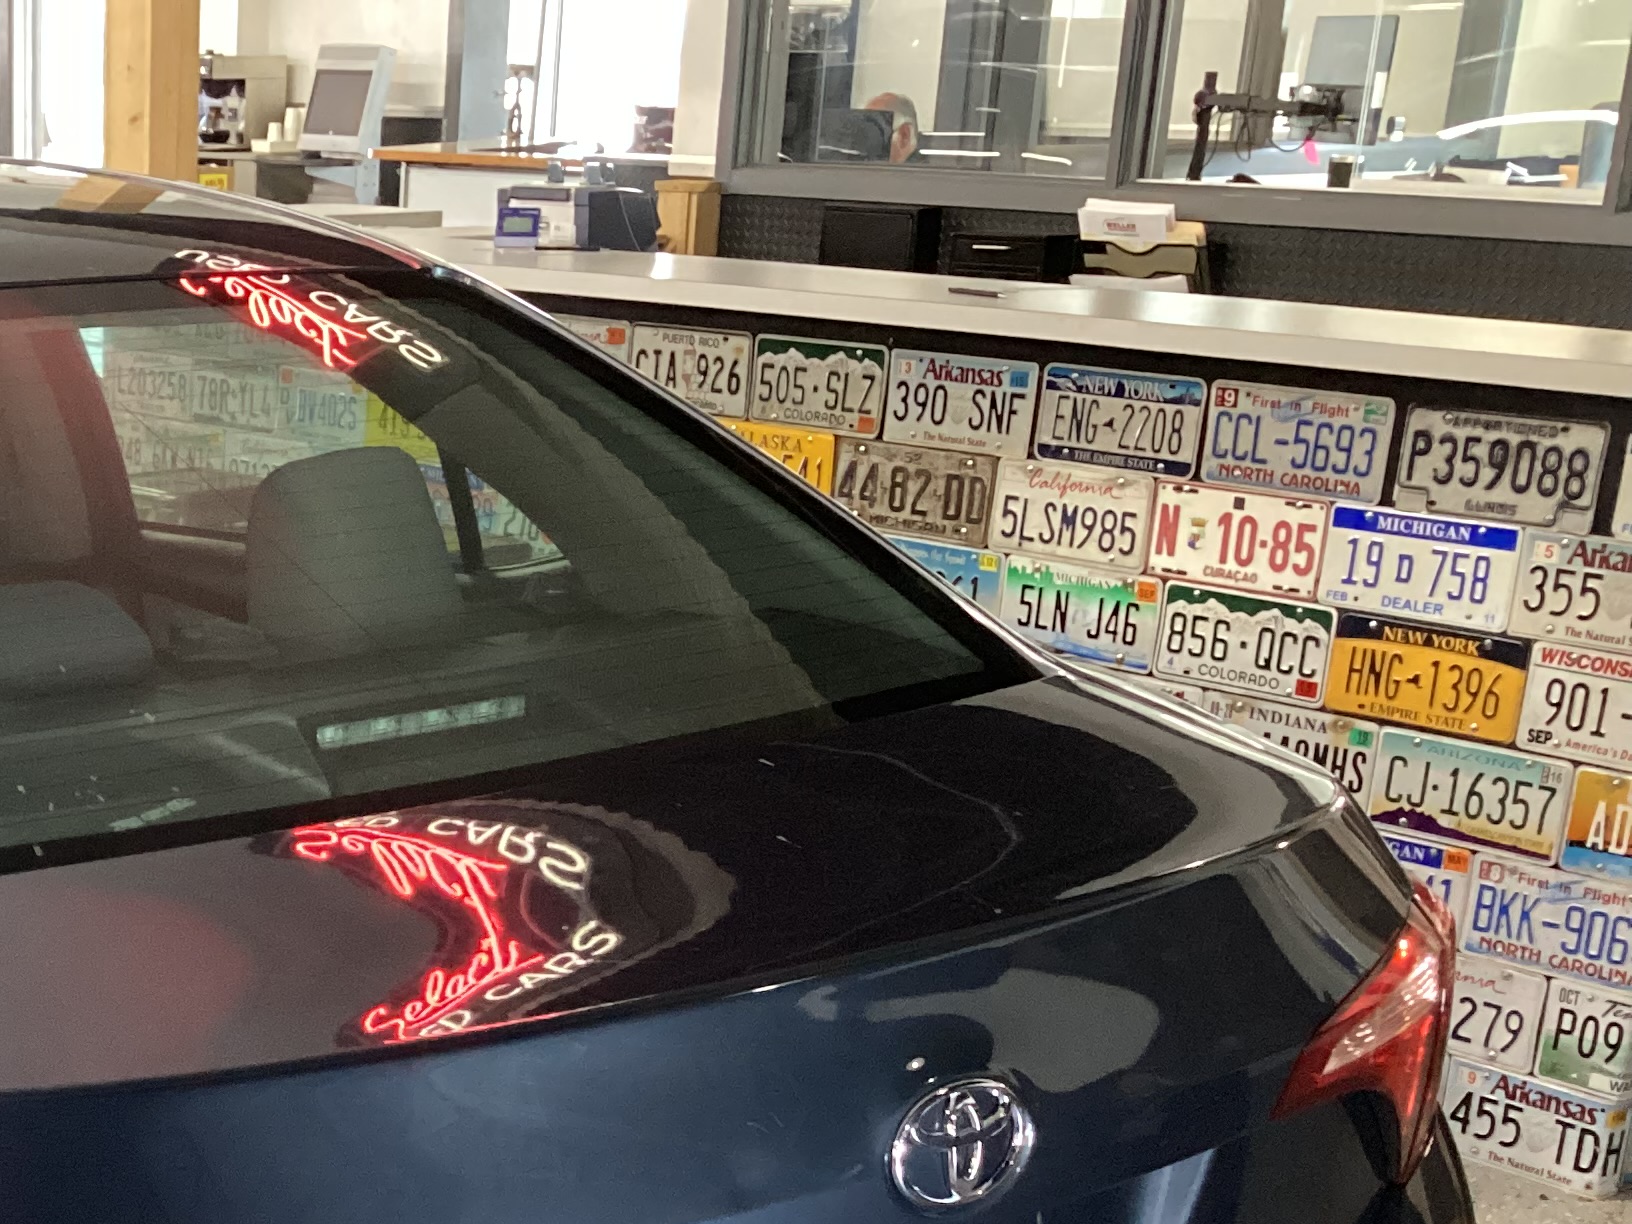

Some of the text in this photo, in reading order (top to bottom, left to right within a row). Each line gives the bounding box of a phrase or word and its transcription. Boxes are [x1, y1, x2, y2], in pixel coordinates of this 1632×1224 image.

[662, 333, 720, 349] PUERTO RICO
[696, 353, 741, 396] 926
[922, 357, 1004, 388] Arkansas
[1082, 375, 1165, 402] NEW YORK
[1224, 389, 1236, 407] 9
[783, 407, 846, 427] COLORADO
[893, 380, 1027, 436] 390 SNF
[741, 431, 802, 454] LASKA
[1211, 409, 1377, 478] CCL-5693
[1073, 450, 1155, 470] THE EMPIRE STATE
[1406, 428, 1591, 502] P359088
[1028, 467, 1125, 500] California
[1217, 462, 1361, 497] NORTH CAROLINA
[1000, 493, 1138, 557] 5LSM985
[1376, 514, 1472, 542] MICHIGAN
[1055, 571, 1112, 590] MICHIGAN
[1341, 537, 1385, 589] 19
[1428, 547, 1491, 605] 758
[1326, 589, 1349, 602] FEB
[1380, 595, 1445, 617] DEALER
[1522, 564, 1605, 621] 355
[1017, 583, 1070, 633] 5LN
[1086, 596, 1140, 647] J46
[1382, 625, 1483, 658] NEW YORK
[1565, 626, 1626, 646] The Natural
[1197, 663, 1280, 691] COLORADO
[1249, 706, 1329, 736] INDIANA
[1369, 701, 1466, 732] EMPIRE STATE
[1527, 728, 1554, 746] SEP
[1478, 935, 1542, 965] NORTH
[1558, 986, 1581, 1006] OCT
[1450, 996, 1525, 1054] 279
[1552, 1006, 1624, 1065] P09
[1489, 1073, 1600, 1128] Arkansas
[1449, 1090, 1627, 1178] 455 TDH
[1487, 1150, 1505, 1165] The
[1506, 1156, 1545, 1178] Natural
